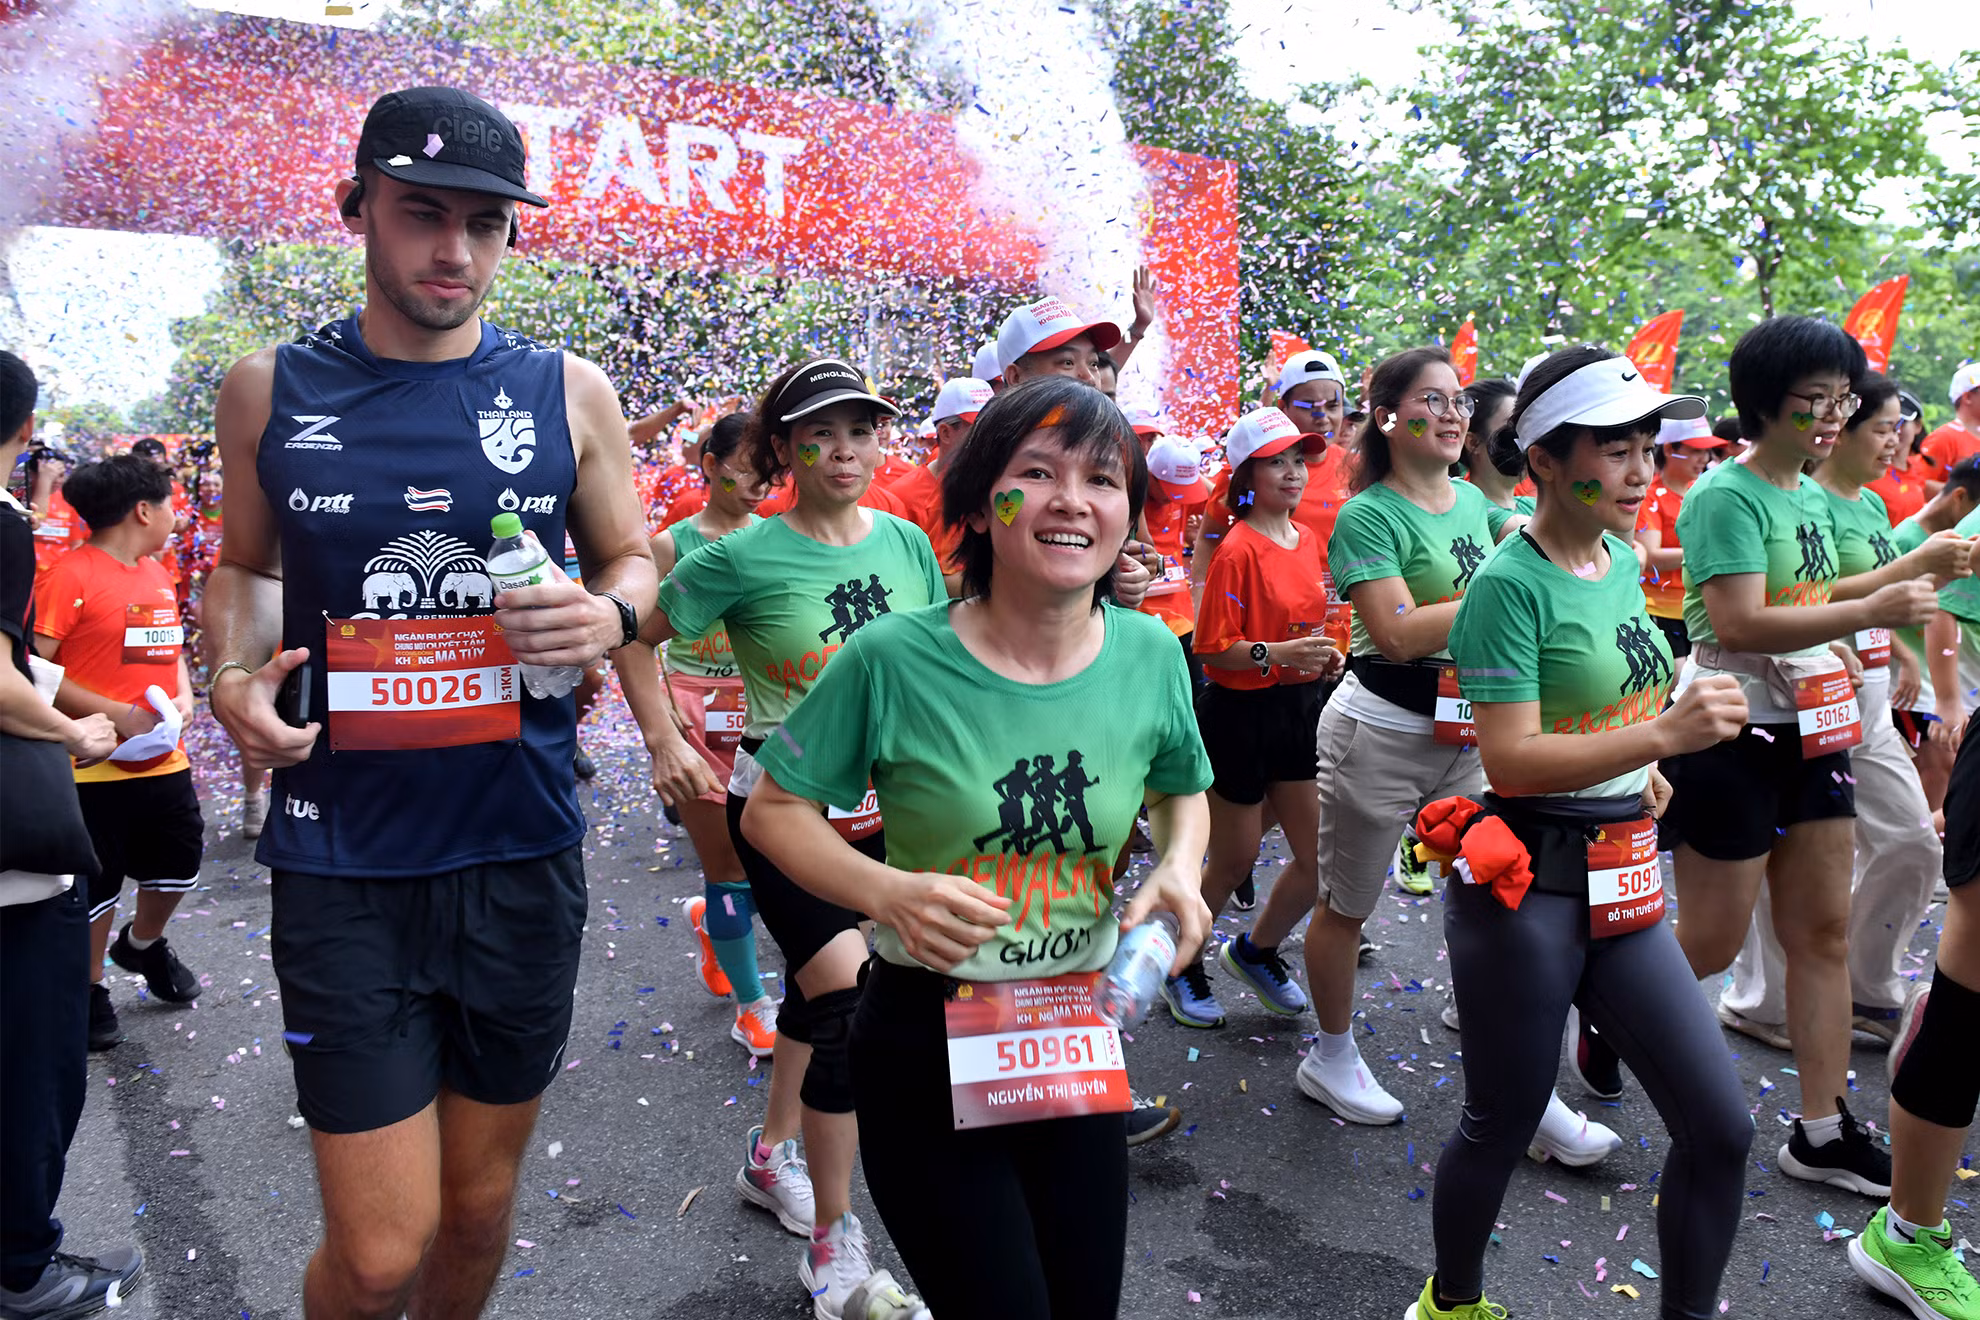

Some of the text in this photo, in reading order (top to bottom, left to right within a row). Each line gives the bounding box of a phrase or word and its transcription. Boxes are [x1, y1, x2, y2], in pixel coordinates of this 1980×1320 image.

[497, 101, 807, 217] TART
[477, 410, 532, 419] THAILAND
[284, 442, 343, 451] CADENZA
[324, 506, 350, 514] Group
[500, 579, 531, 590] Dasan
[435, 649, 457, 663] MA
[372, 673, 482, 705] 50026
[501, 666, 512, 701] 5.1KM
[1456, 702, 1473, 720] 10
[1816, 705, 1850, 728] 50162
[726, 714, 744, 728] 50
[285, 793, 320, 820] true
[1017, 1012, 1054, 1024] KHNG
[997, 1033, 1095, 1072] 50961
[988, 1078, 1107, 1106] NGUYỄN THỊ DUYÊN
